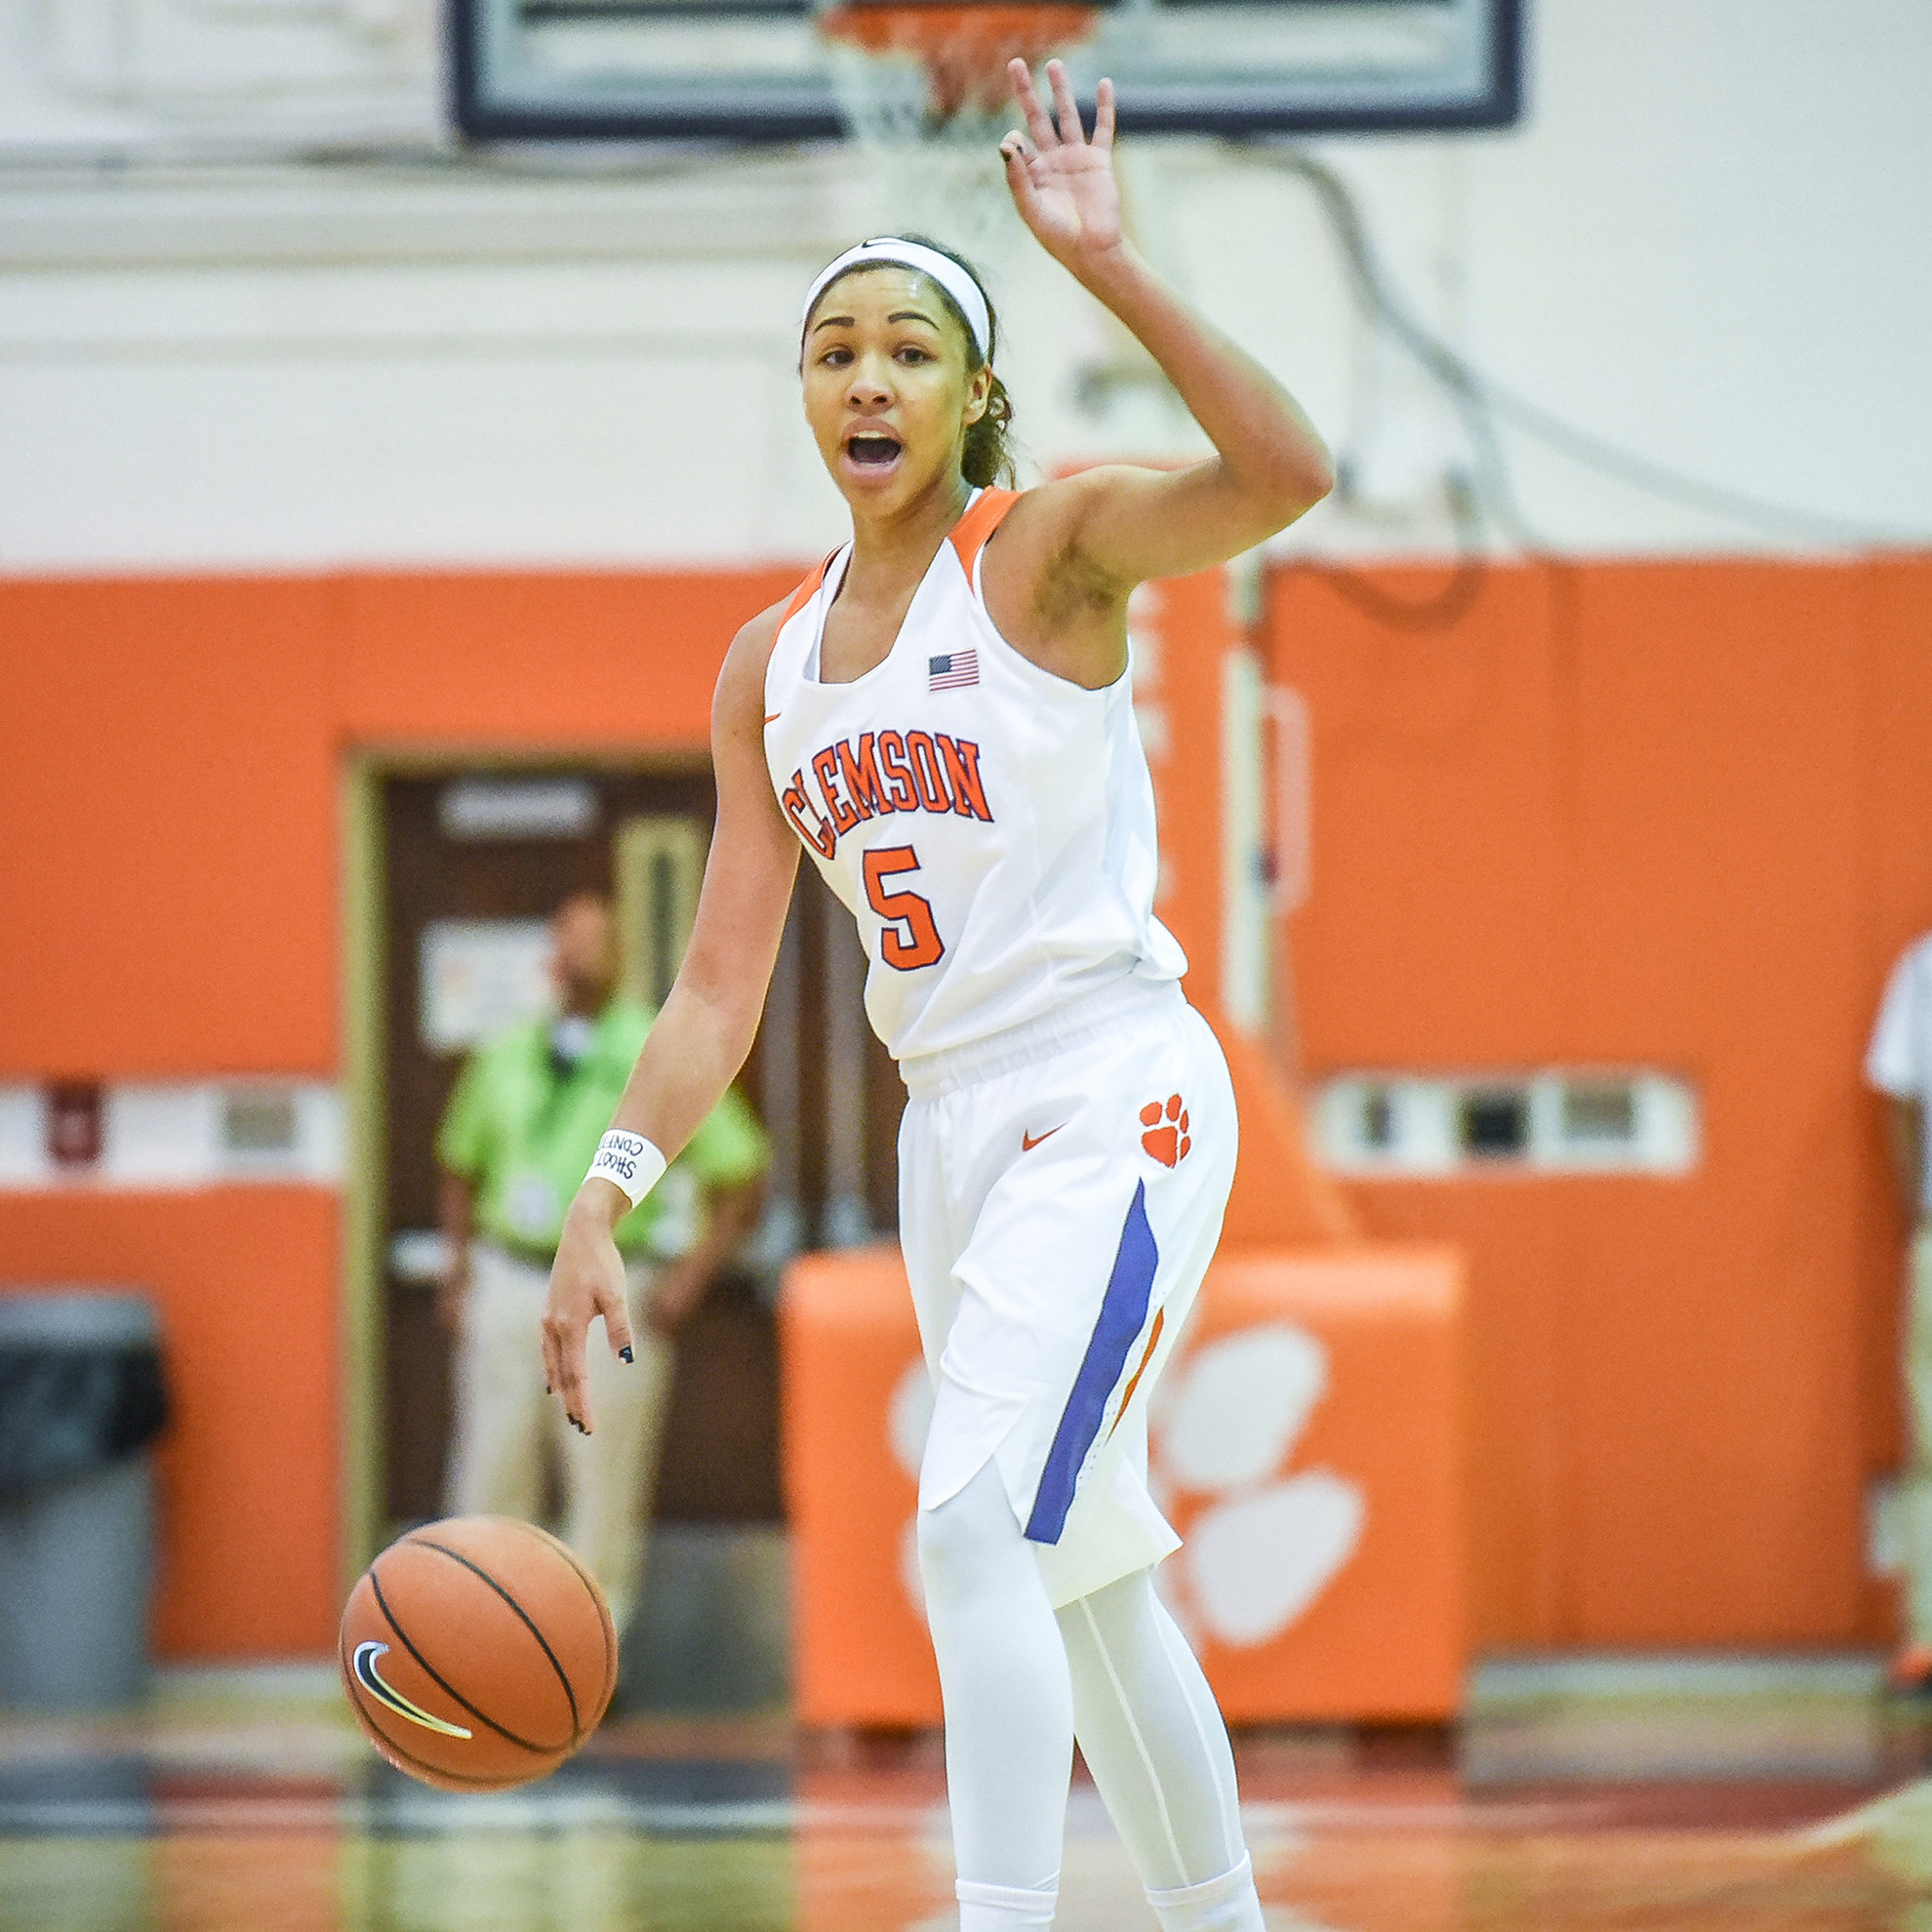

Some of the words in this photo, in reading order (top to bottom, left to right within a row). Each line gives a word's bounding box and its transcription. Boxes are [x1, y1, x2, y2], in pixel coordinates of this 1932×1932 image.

[782, 730, 994, 860] CLEMSON
[863, 844, 946, 972] 5
[595, 1151, 636, 1179] SHOOT
